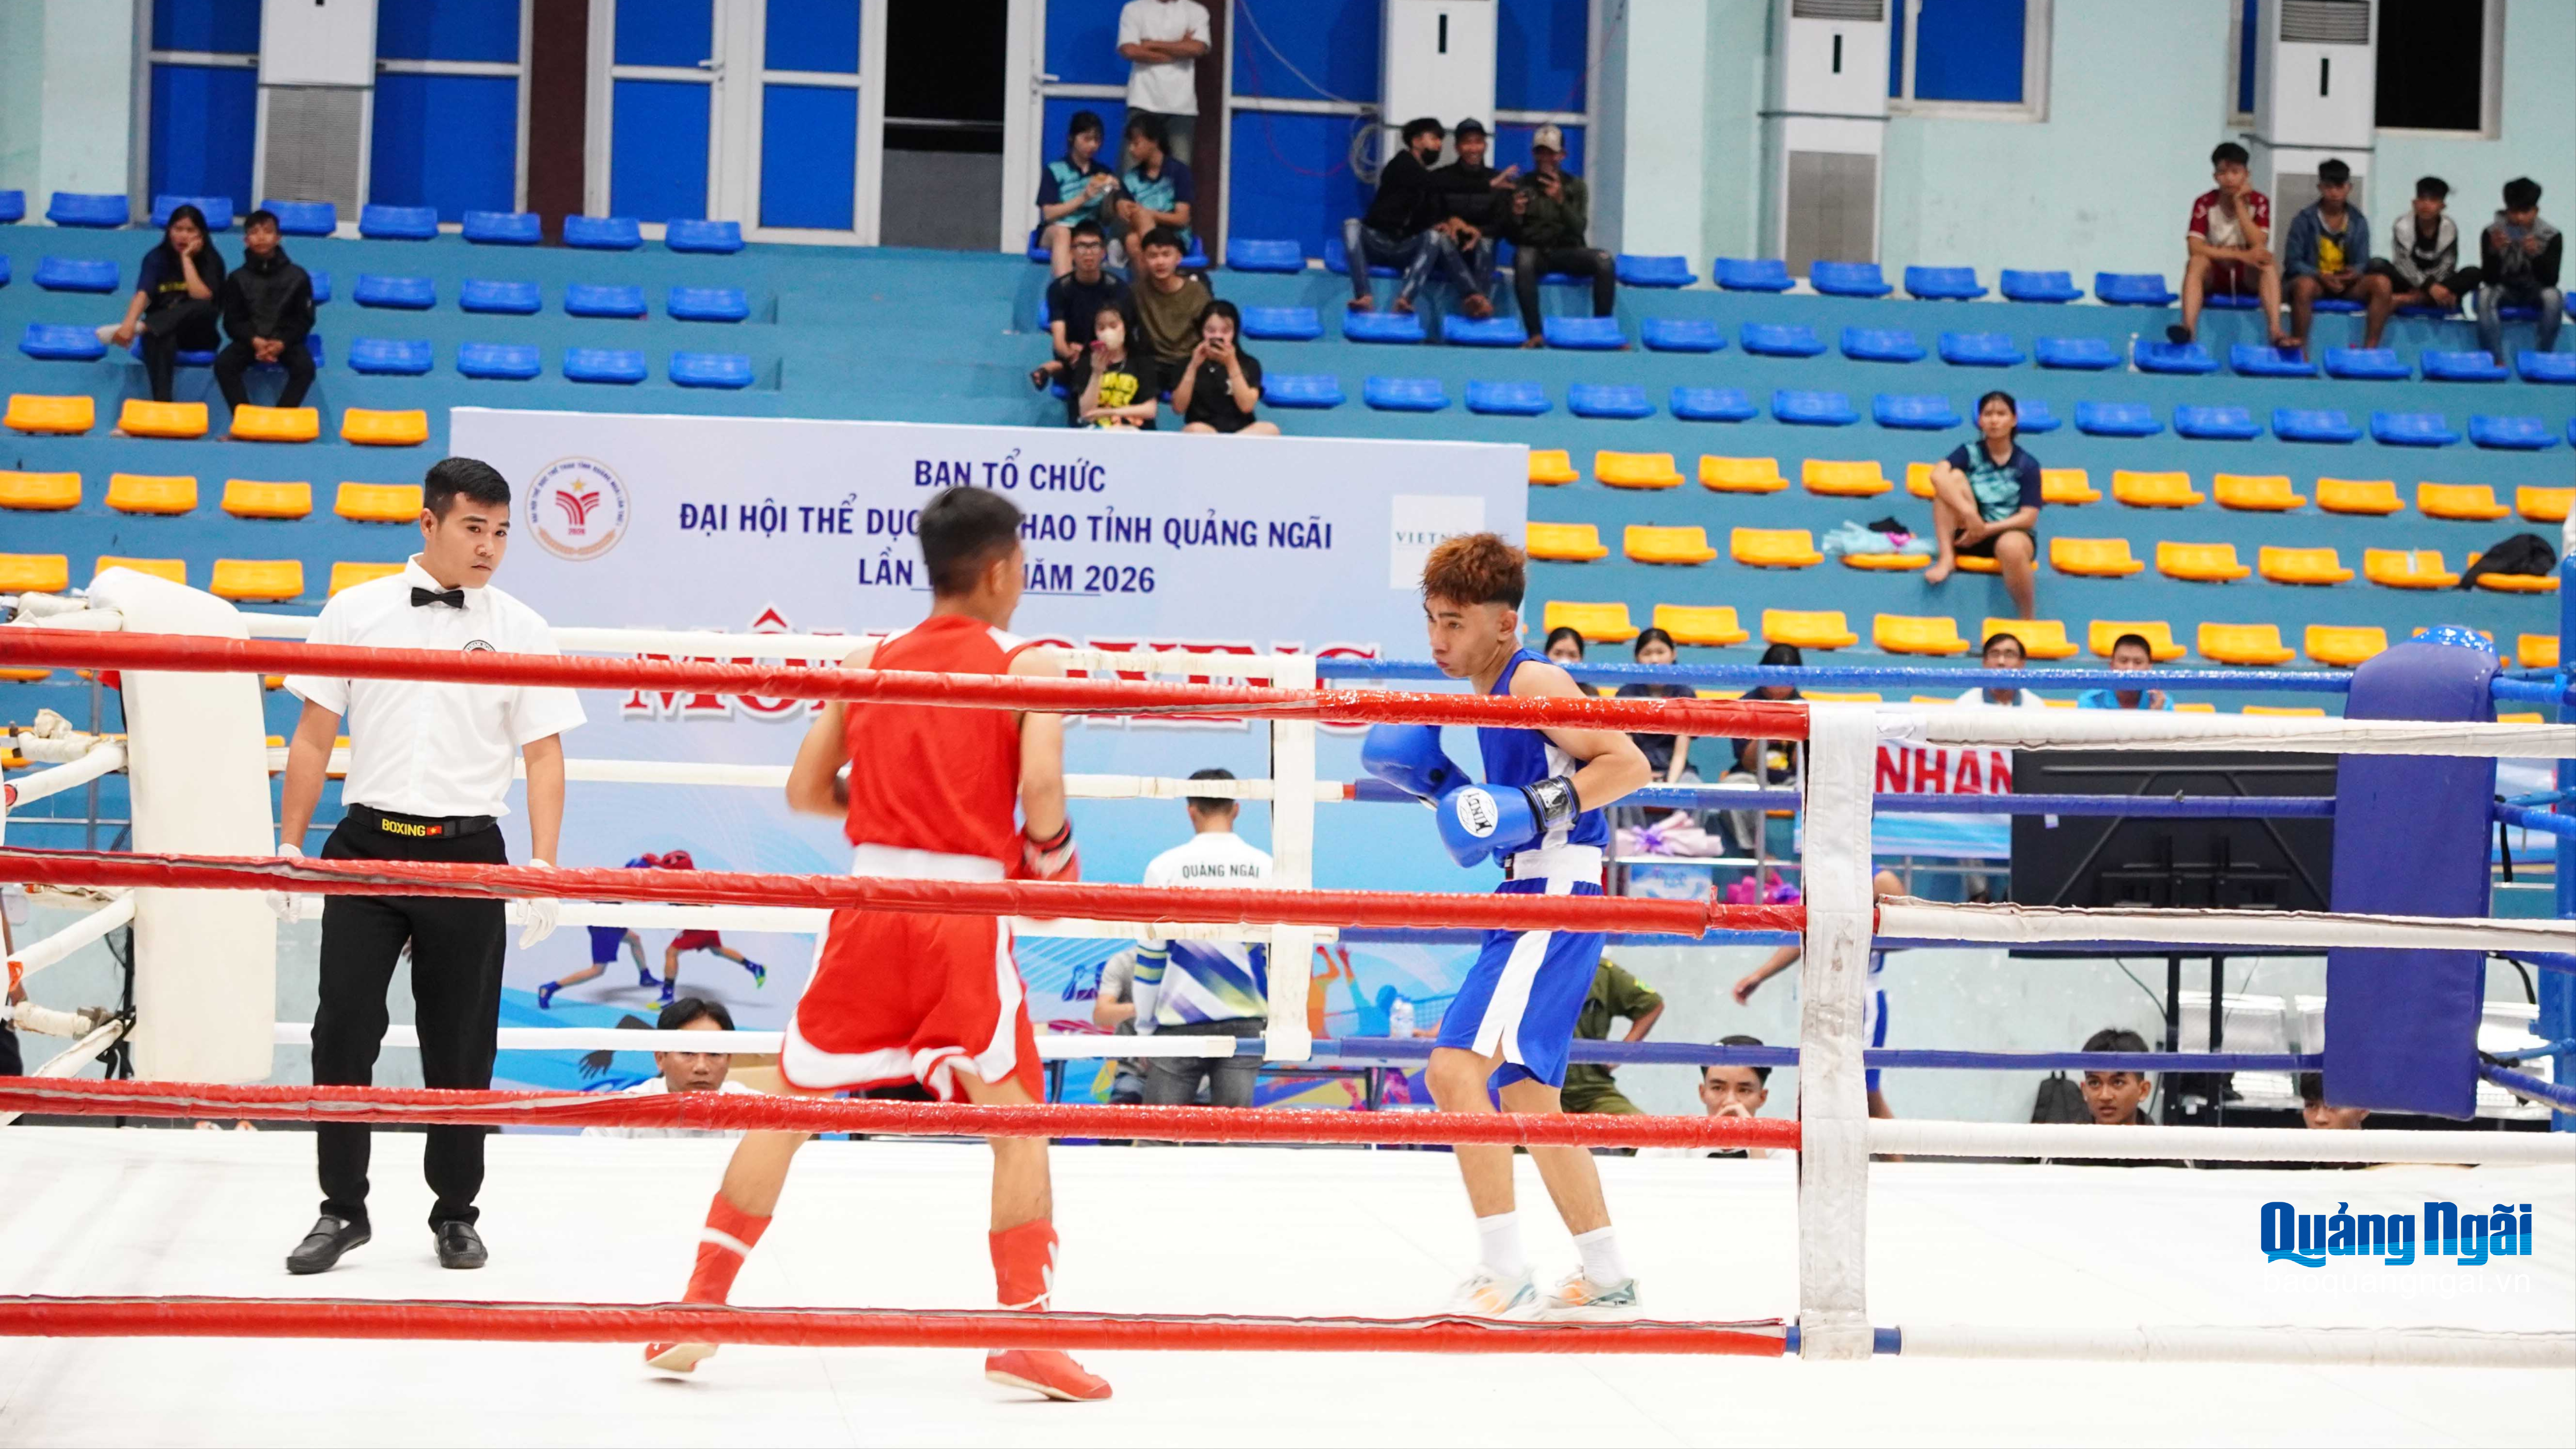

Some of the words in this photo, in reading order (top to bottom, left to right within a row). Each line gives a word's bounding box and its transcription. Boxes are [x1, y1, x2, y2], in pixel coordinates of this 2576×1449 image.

[915, 460, 972, 486] BAN
[982, 448, 1021, 489] TỔ
[1029, 457, 1106, 492] CHỨC
[679, 503, 727, 536] ĐẠI
[739, 498, 787, 538] HỘI
[798, 492, 857, 535] THỂ
[1021, 514, 1077, 541] HAO
[1086, 505, 1152, 543] TỈNH
[1163, 508, 1257, 550] QUẢNG
[1269, 514, 1332, 549] NGÃI
[859, 546, 913, 586] LẦN
[1023, 558, 1073, 591] ĂM
[1084, 565, 1156, 594] 2026
[382, 818, 426, 836] BOXING
